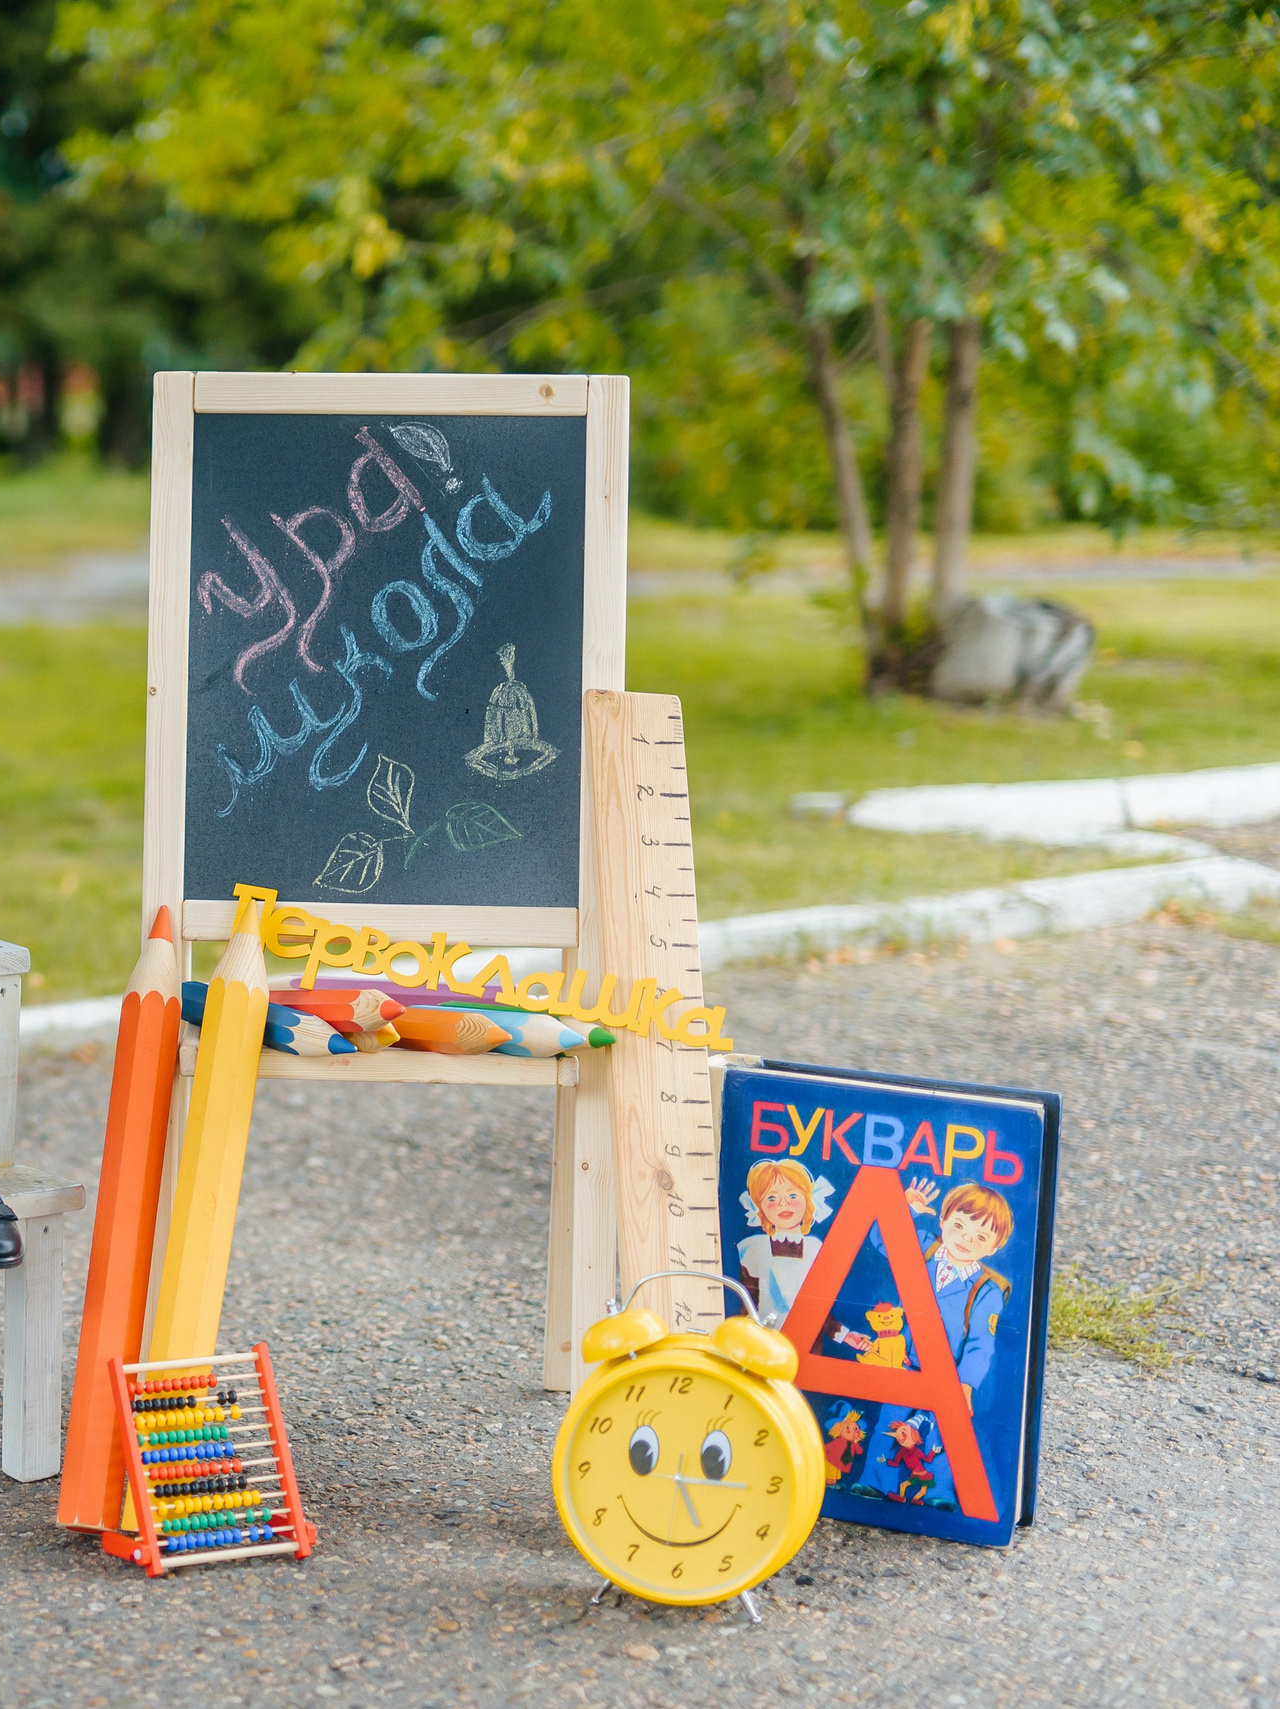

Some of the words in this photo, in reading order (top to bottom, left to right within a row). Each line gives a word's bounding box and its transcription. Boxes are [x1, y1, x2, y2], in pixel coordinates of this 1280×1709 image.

[214, 472, 553, 819] школа
[631, 732, 650, 745] 1
[636, 783, 655, 802] 2
[641, 833, 660, 846] 3
[644, 885, 662, 898] 4
[649, 934, 667, 951] 5
[229, 882, 734, 1052] Первоклашка
[660, 1090, 678, 1104] 8
[664, 1143, 681, 1158] 9
[749, 1099, 1025, 1185] БУКВАРЬ
[667, 1189, 685, 1218] 10
[778, 1164, 1000, 1524] А
[624, 1385, 647, 1403] 11
[669, 1376, 694, 1395] 12
[723, 1393, 735, 1411] 1
[589, 1416, 614, 1435] 10
[753, 1429, 770, 1448] 2
[577, 1461, 592, 1480] 9
[766, 1476, 784, 1495] 3
[592, 1508, 607, 1527] 8
[755, 1523, 772, 1542] 4
[627, 1543, 641, 1562] 7
[671, 1562, 684, 1579] 6
[718, 1555, 734, 1573] 5
